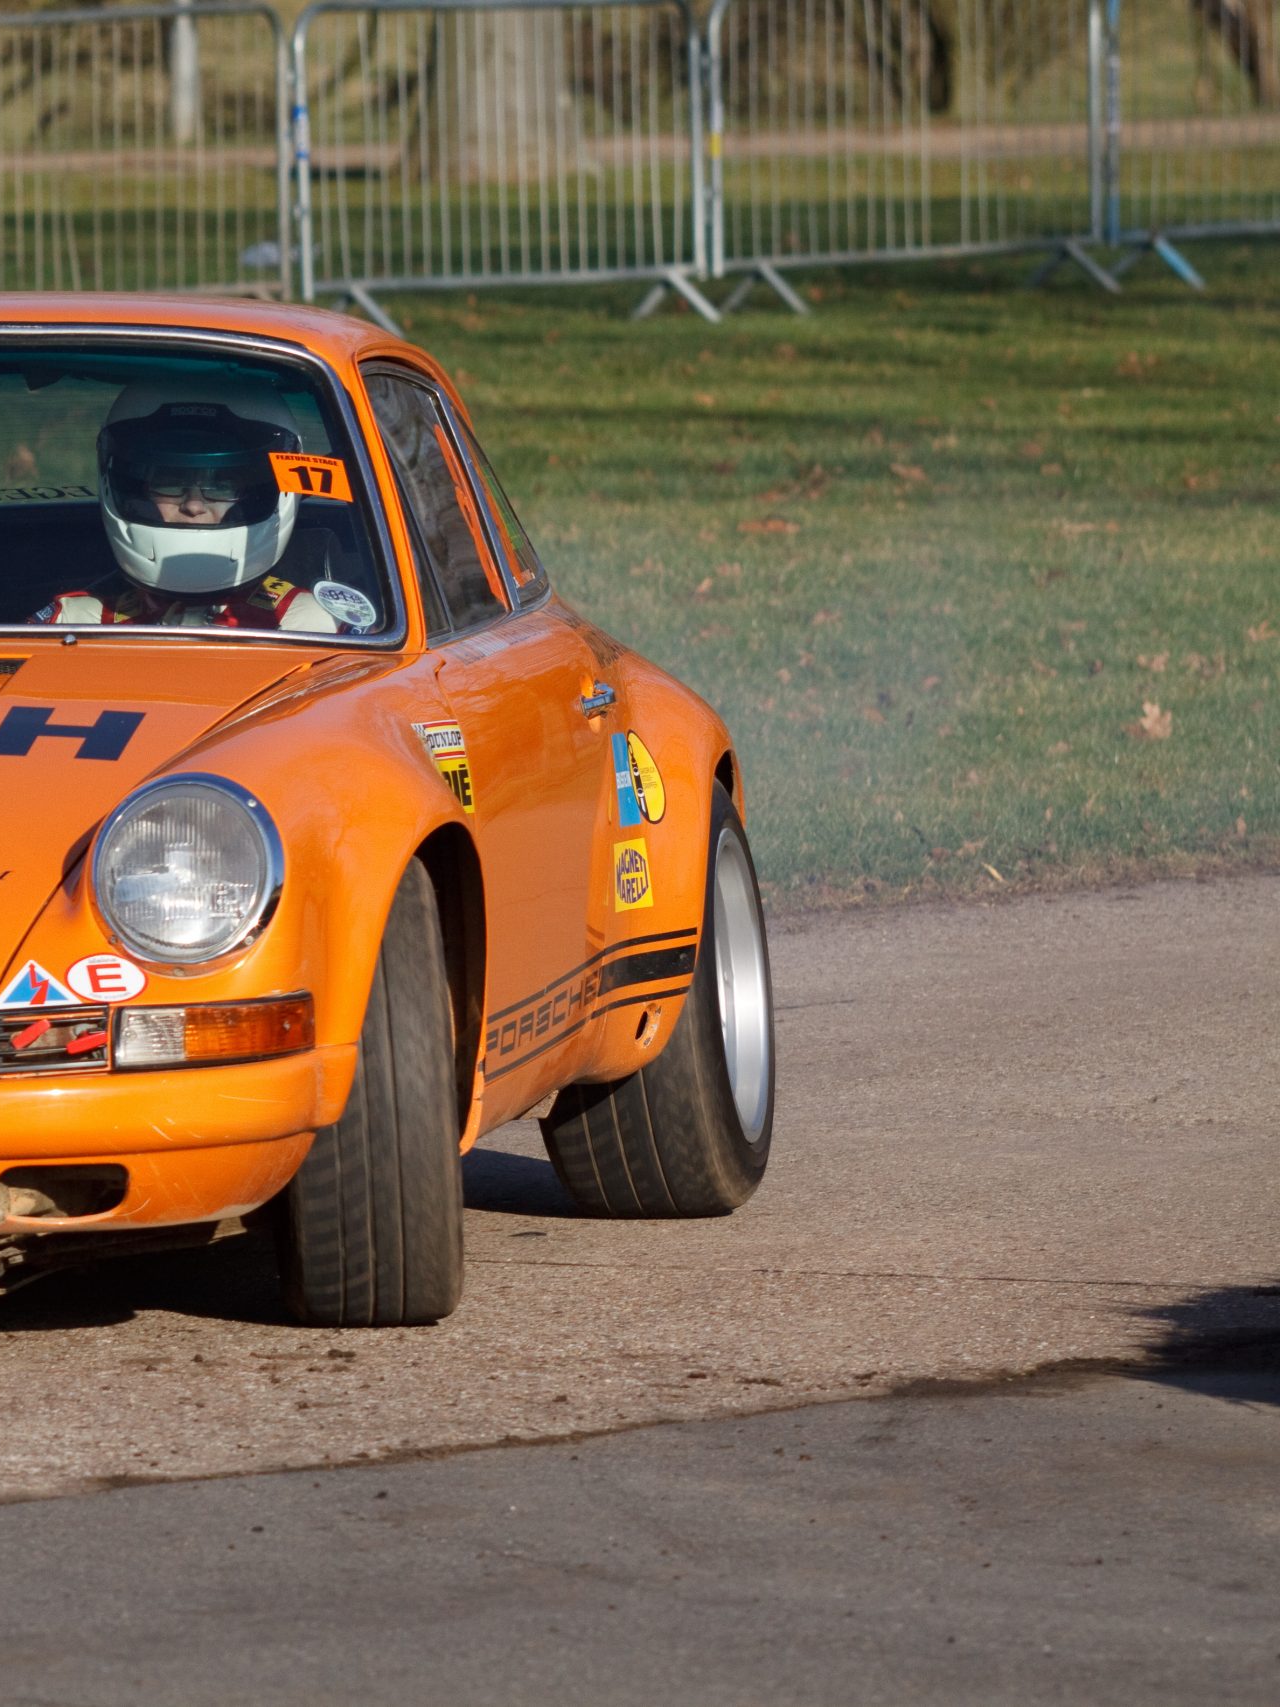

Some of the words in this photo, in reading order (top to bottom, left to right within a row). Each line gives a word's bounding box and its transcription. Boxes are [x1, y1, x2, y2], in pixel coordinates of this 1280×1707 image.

[276, 455, 311, 463] FEATURE
[288, 466, 333, 494] 17
[427, 731, 462, 749] DUNLOP
[87, 963, 127, 993] E
[486, 970, 598, 1056] PORSCHE
